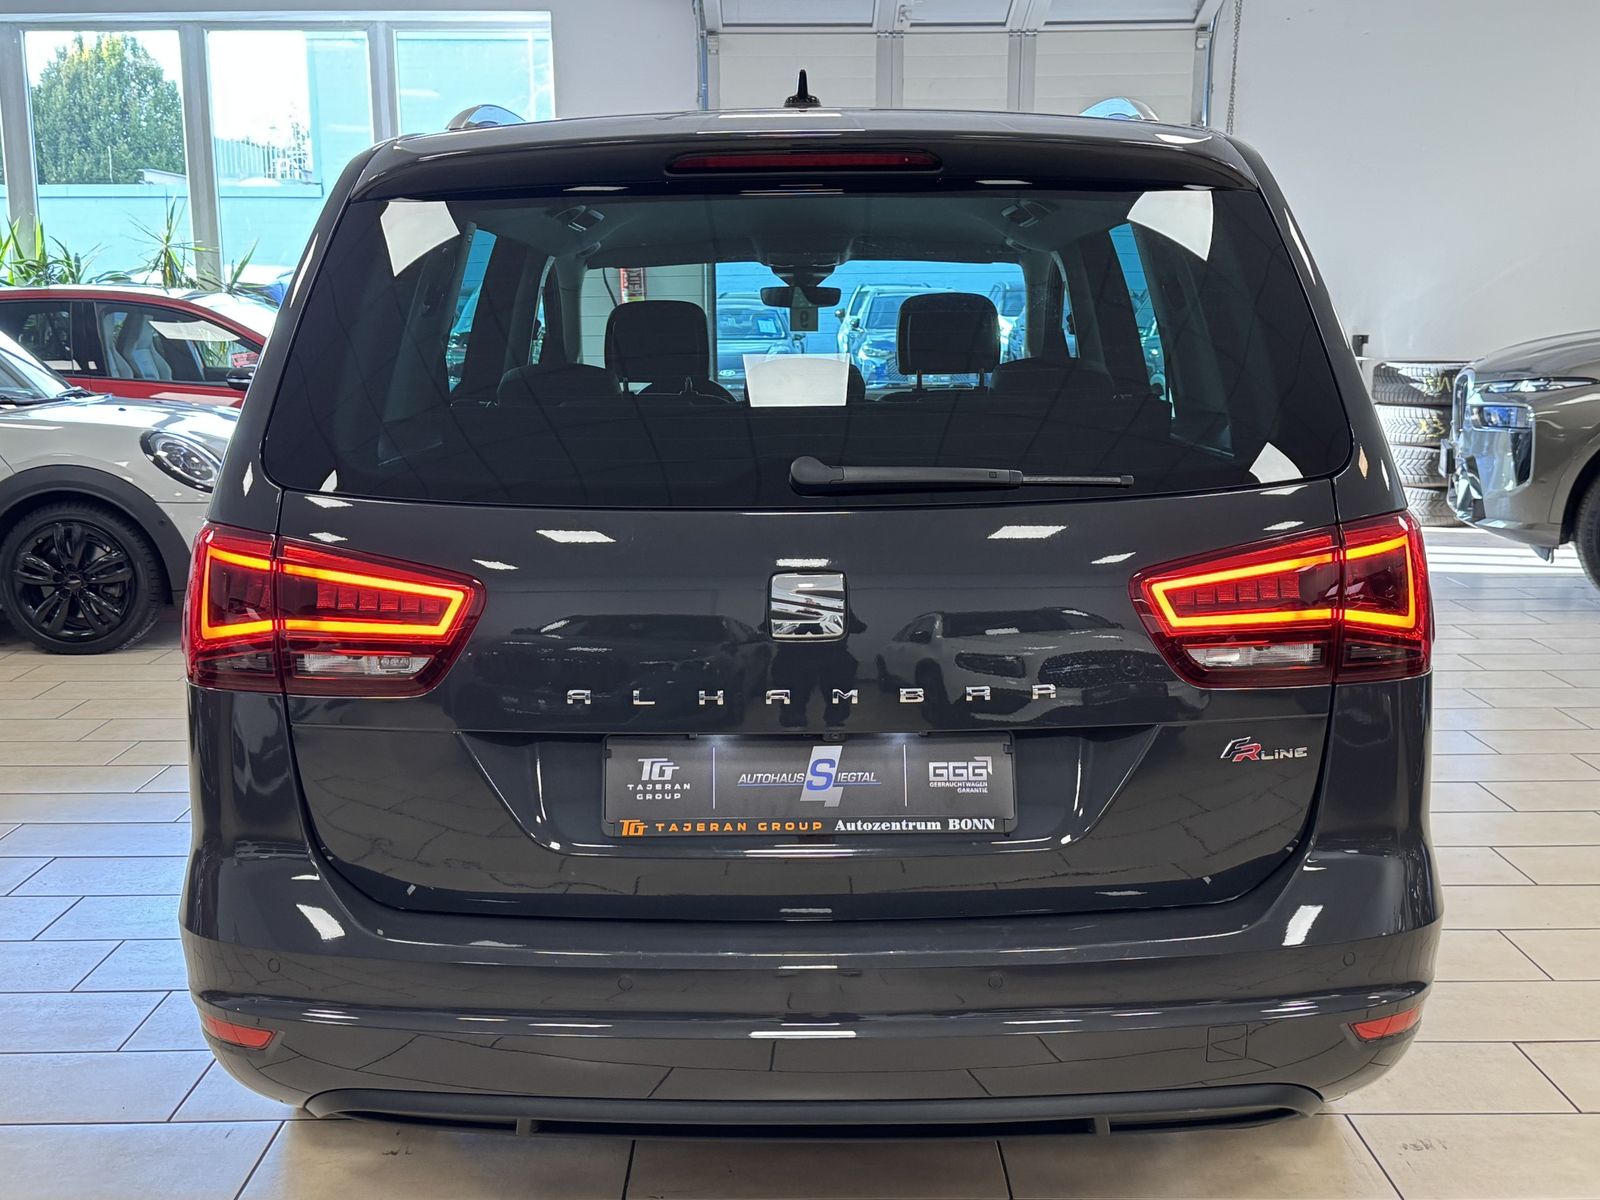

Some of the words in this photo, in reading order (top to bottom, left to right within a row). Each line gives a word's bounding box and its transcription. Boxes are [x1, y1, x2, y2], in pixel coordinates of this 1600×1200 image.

[567, 683, 1057, 706] ALHAMBRA
[1220, 736, 1262, 762] FR
[737, 773, 805, 783] AUTOHAUS
[929, 761, 988, 781] GGG
[627, 783, 691, 791] TAJERAN
[655, 821, 748, 832] TAJERAN
[757, 821, 823, 831] GROUP
[834, 819, 942, 831] Autozentrum
[947, 818, 996, 831] BONN
